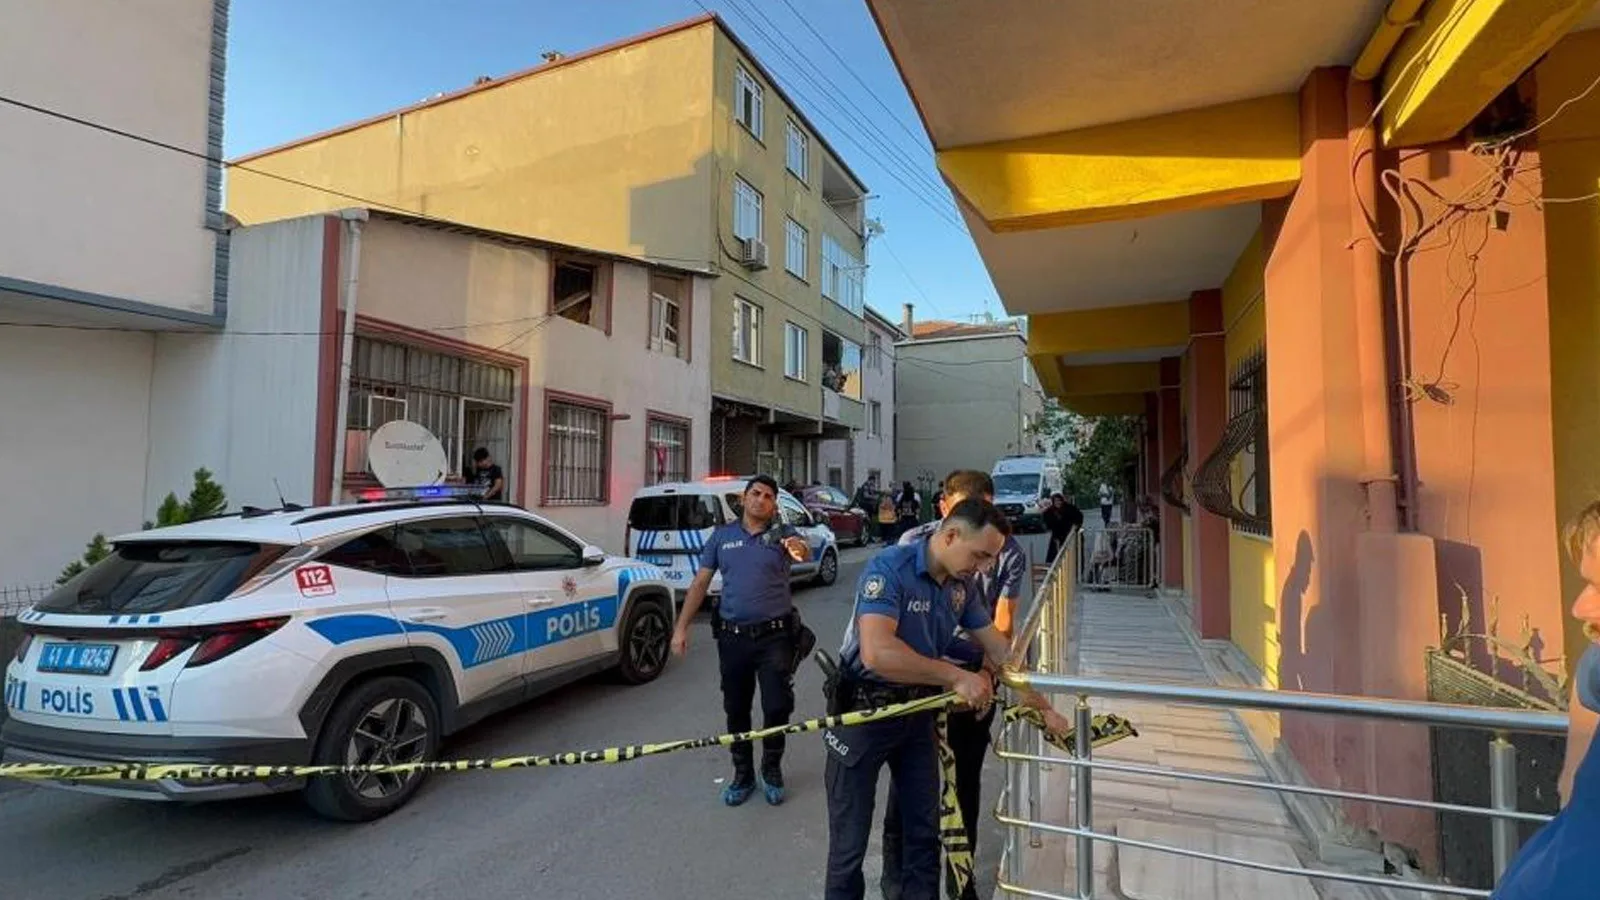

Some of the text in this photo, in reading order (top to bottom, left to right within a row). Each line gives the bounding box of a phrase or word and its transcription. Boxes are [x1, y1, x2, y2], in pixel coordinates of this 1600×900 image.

[300, 569, 328, 586] 112
[546, 603, 600, 641] POLİS
[65, 646, 77, 667] A
[41, 686, 94, 714] POLİS
